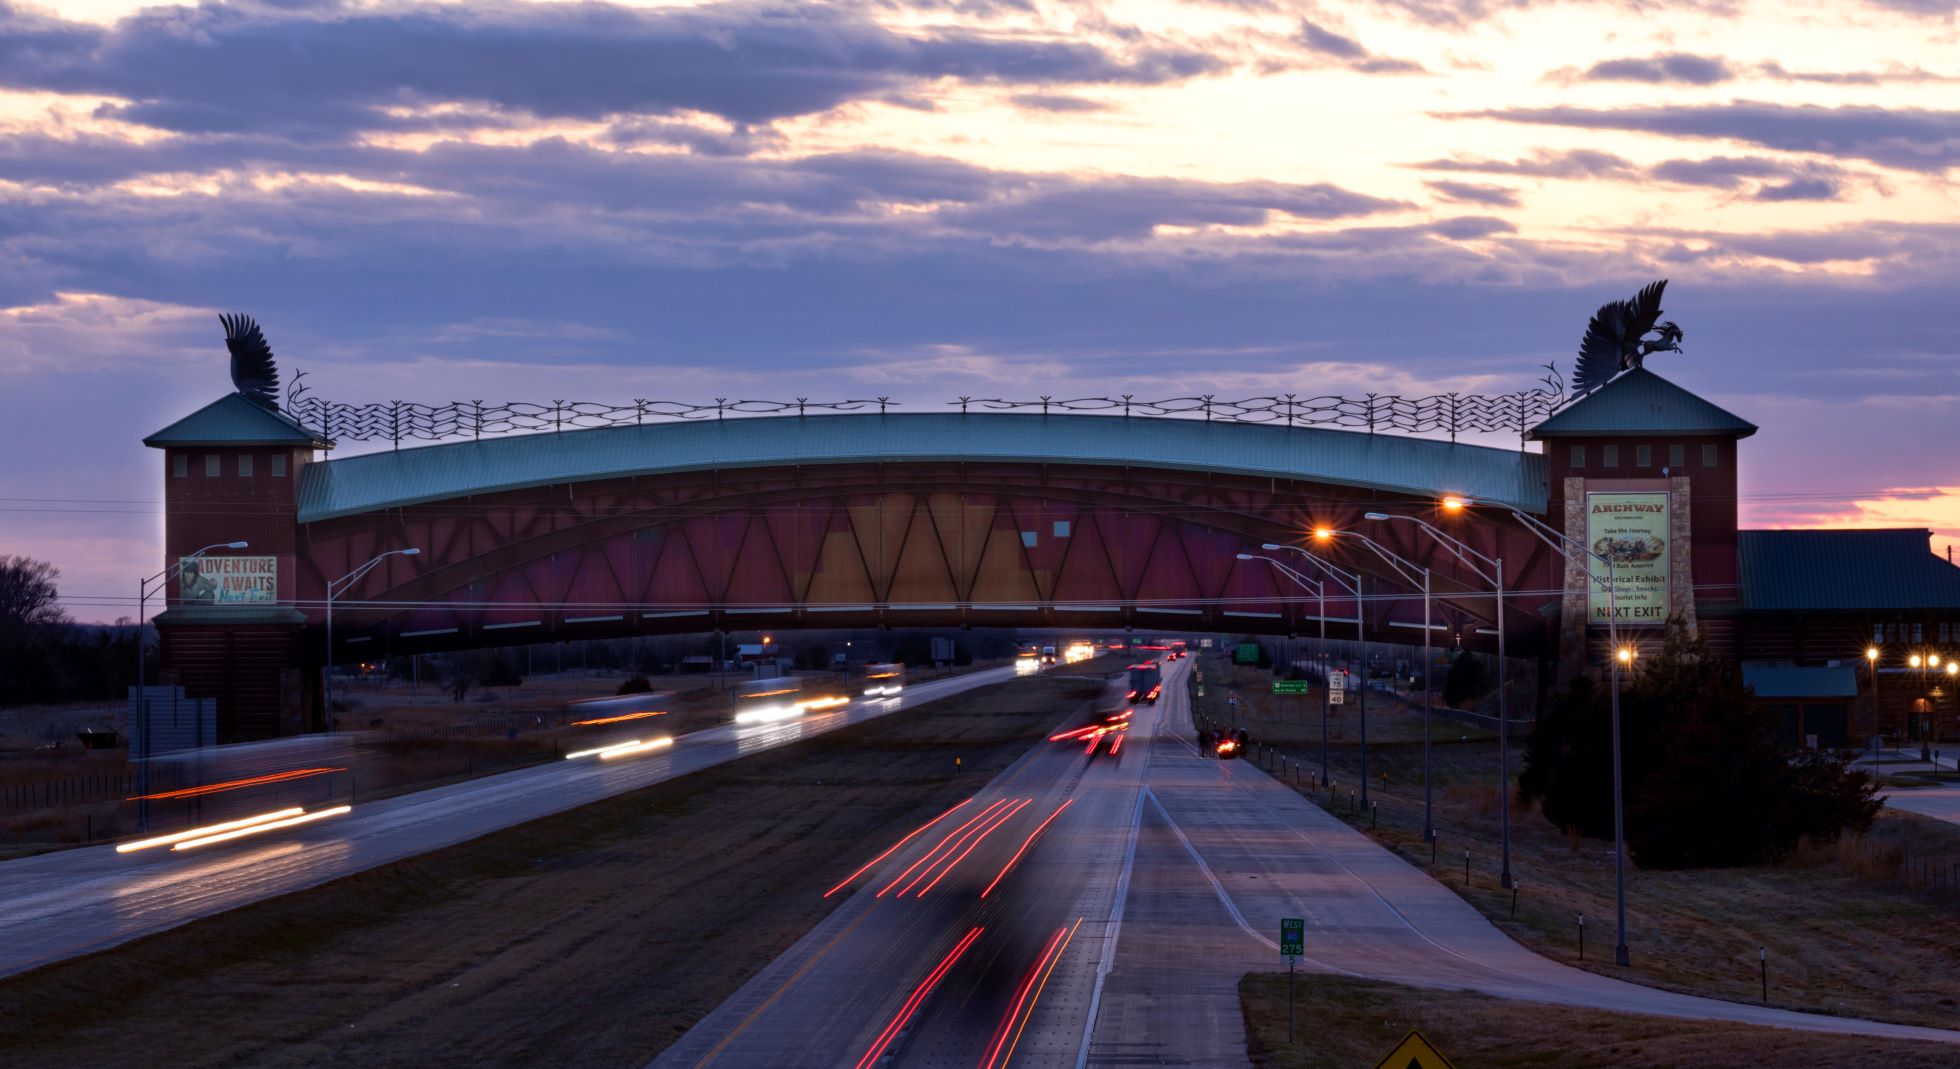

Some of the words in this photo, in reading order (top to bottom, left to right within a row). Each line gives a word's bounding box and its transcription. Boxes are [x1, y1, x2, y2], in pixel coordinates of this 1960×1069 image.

[1592, 503, 1665, 513] ARCHWAY
[1629, 527, 1652, 535] Journey
[199, 559, 274, 574] ADVENTURE
[223, 576, 274, 591] AWAITS
[1635, 575, 1665, 583] Exhibit
[220, 588, 245, 602] Next
[250, 588, 273, 602] Exit
[1634, 606, 1663, 617] EXIT
[1283, 919, 1302, 928] WEST
[1282, 944, 1302, 954] 275
[1289, 955, 1296, 965] 5
